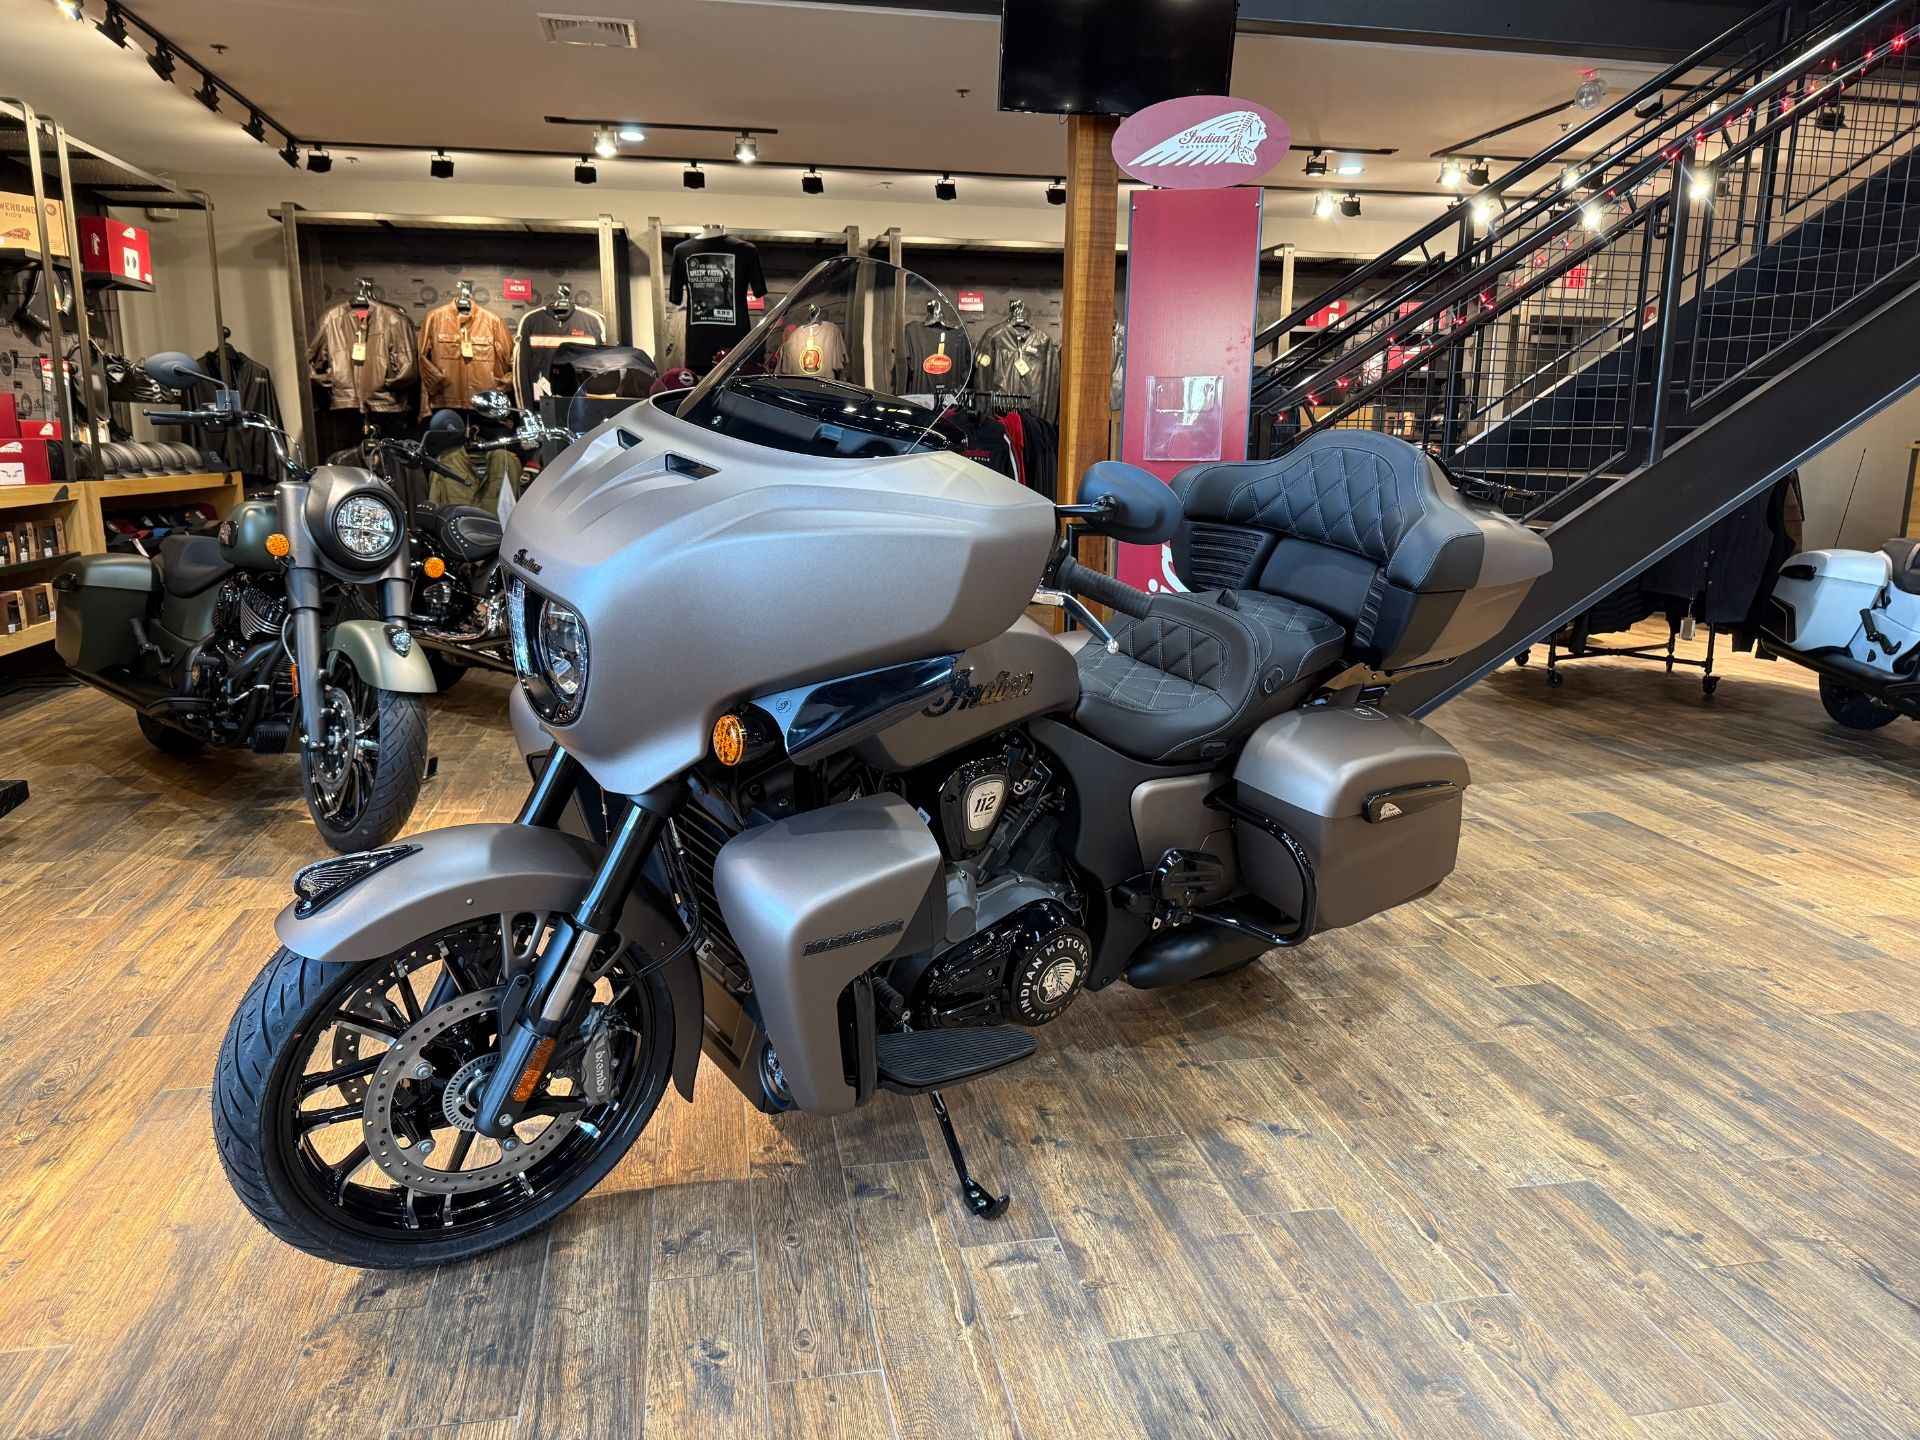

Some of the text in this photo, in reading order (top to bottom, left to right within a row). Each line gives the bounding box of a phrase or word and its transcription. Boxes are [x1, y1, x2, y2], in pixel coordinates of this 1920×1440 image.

[1178, 130, 1230, 144] Indian
[920, 668, 1034, 717] Indian
[974, 795, 997, 813] 112
[1020, 957, 1043, 1013] INDIAN
[1045, 938, 1089, 995] MOTORCYCLE
[595, 1049, 607, 1093] brembo
